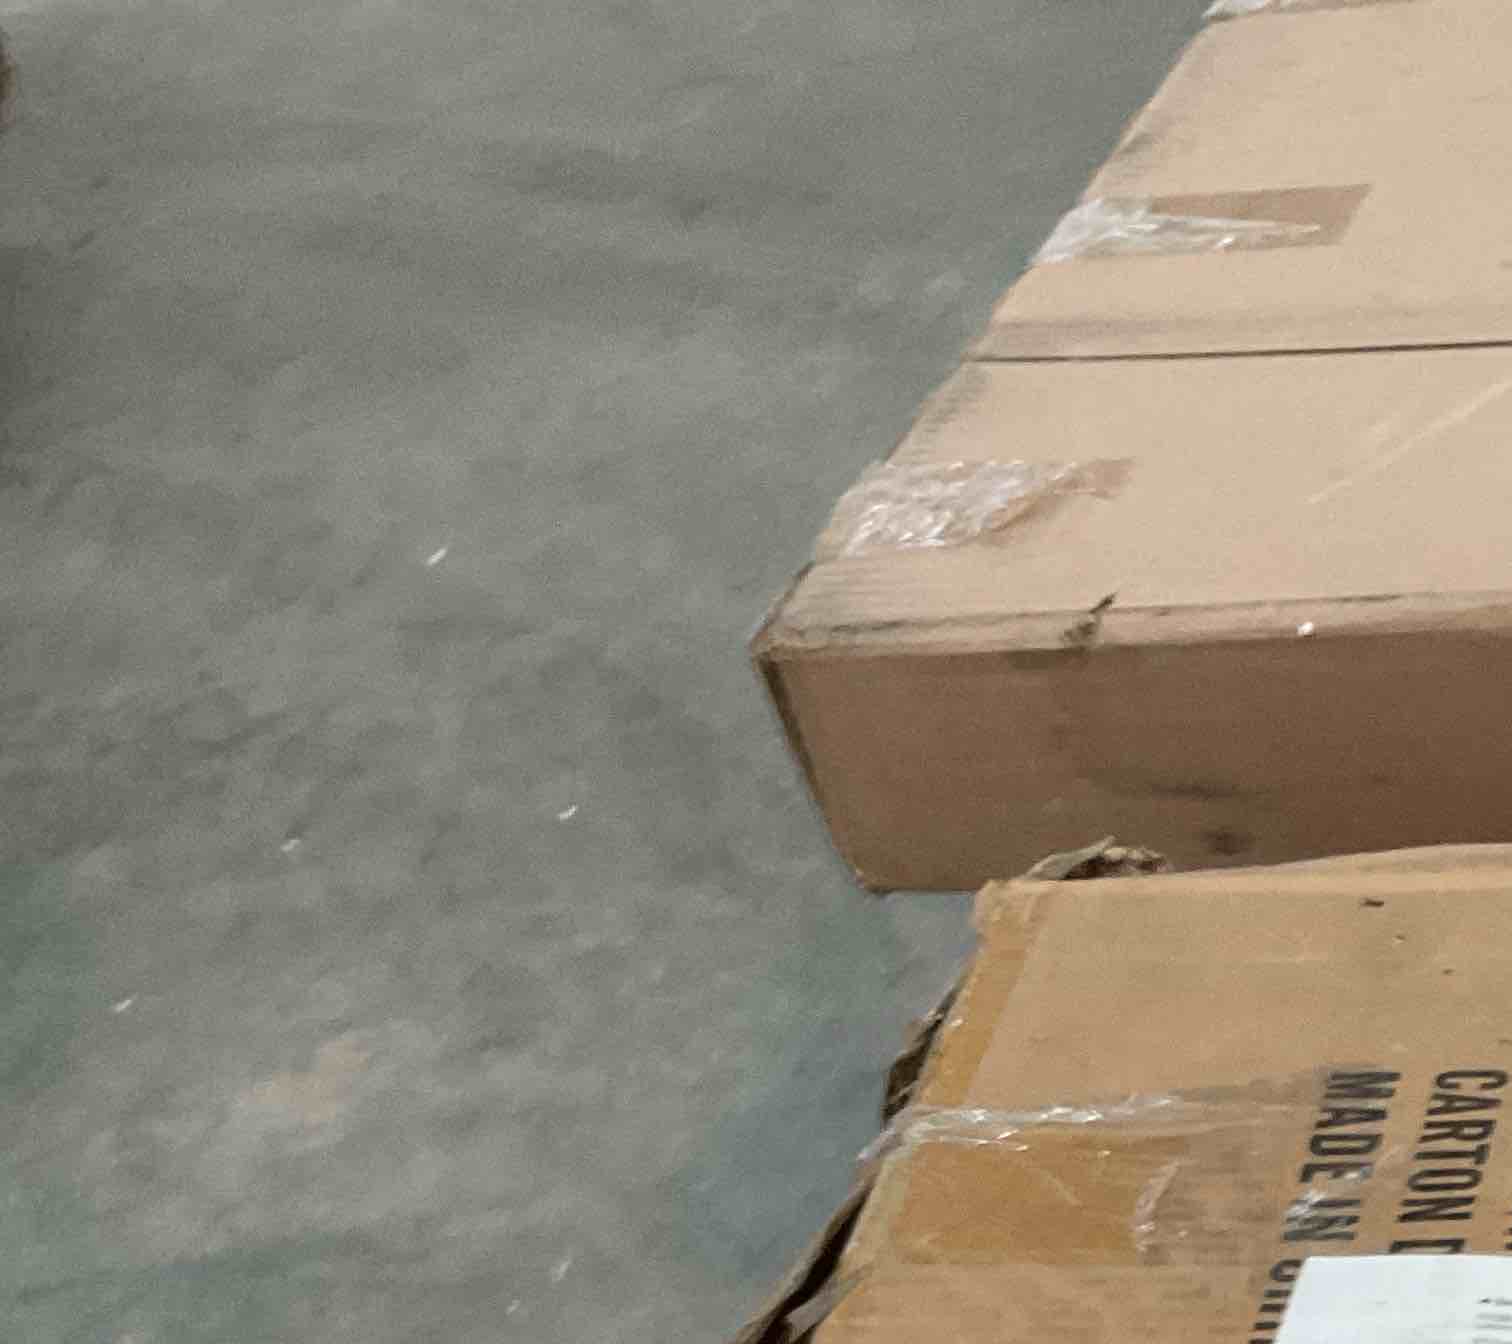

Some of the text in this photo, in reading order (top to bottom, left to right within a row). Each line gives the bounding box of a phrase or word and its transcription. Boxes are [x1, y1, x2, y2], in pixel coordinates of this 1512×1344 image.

[1283, 1071, 1402, 1242] MADE IN
[1395, 1069, 1510, 1224] CARTON
